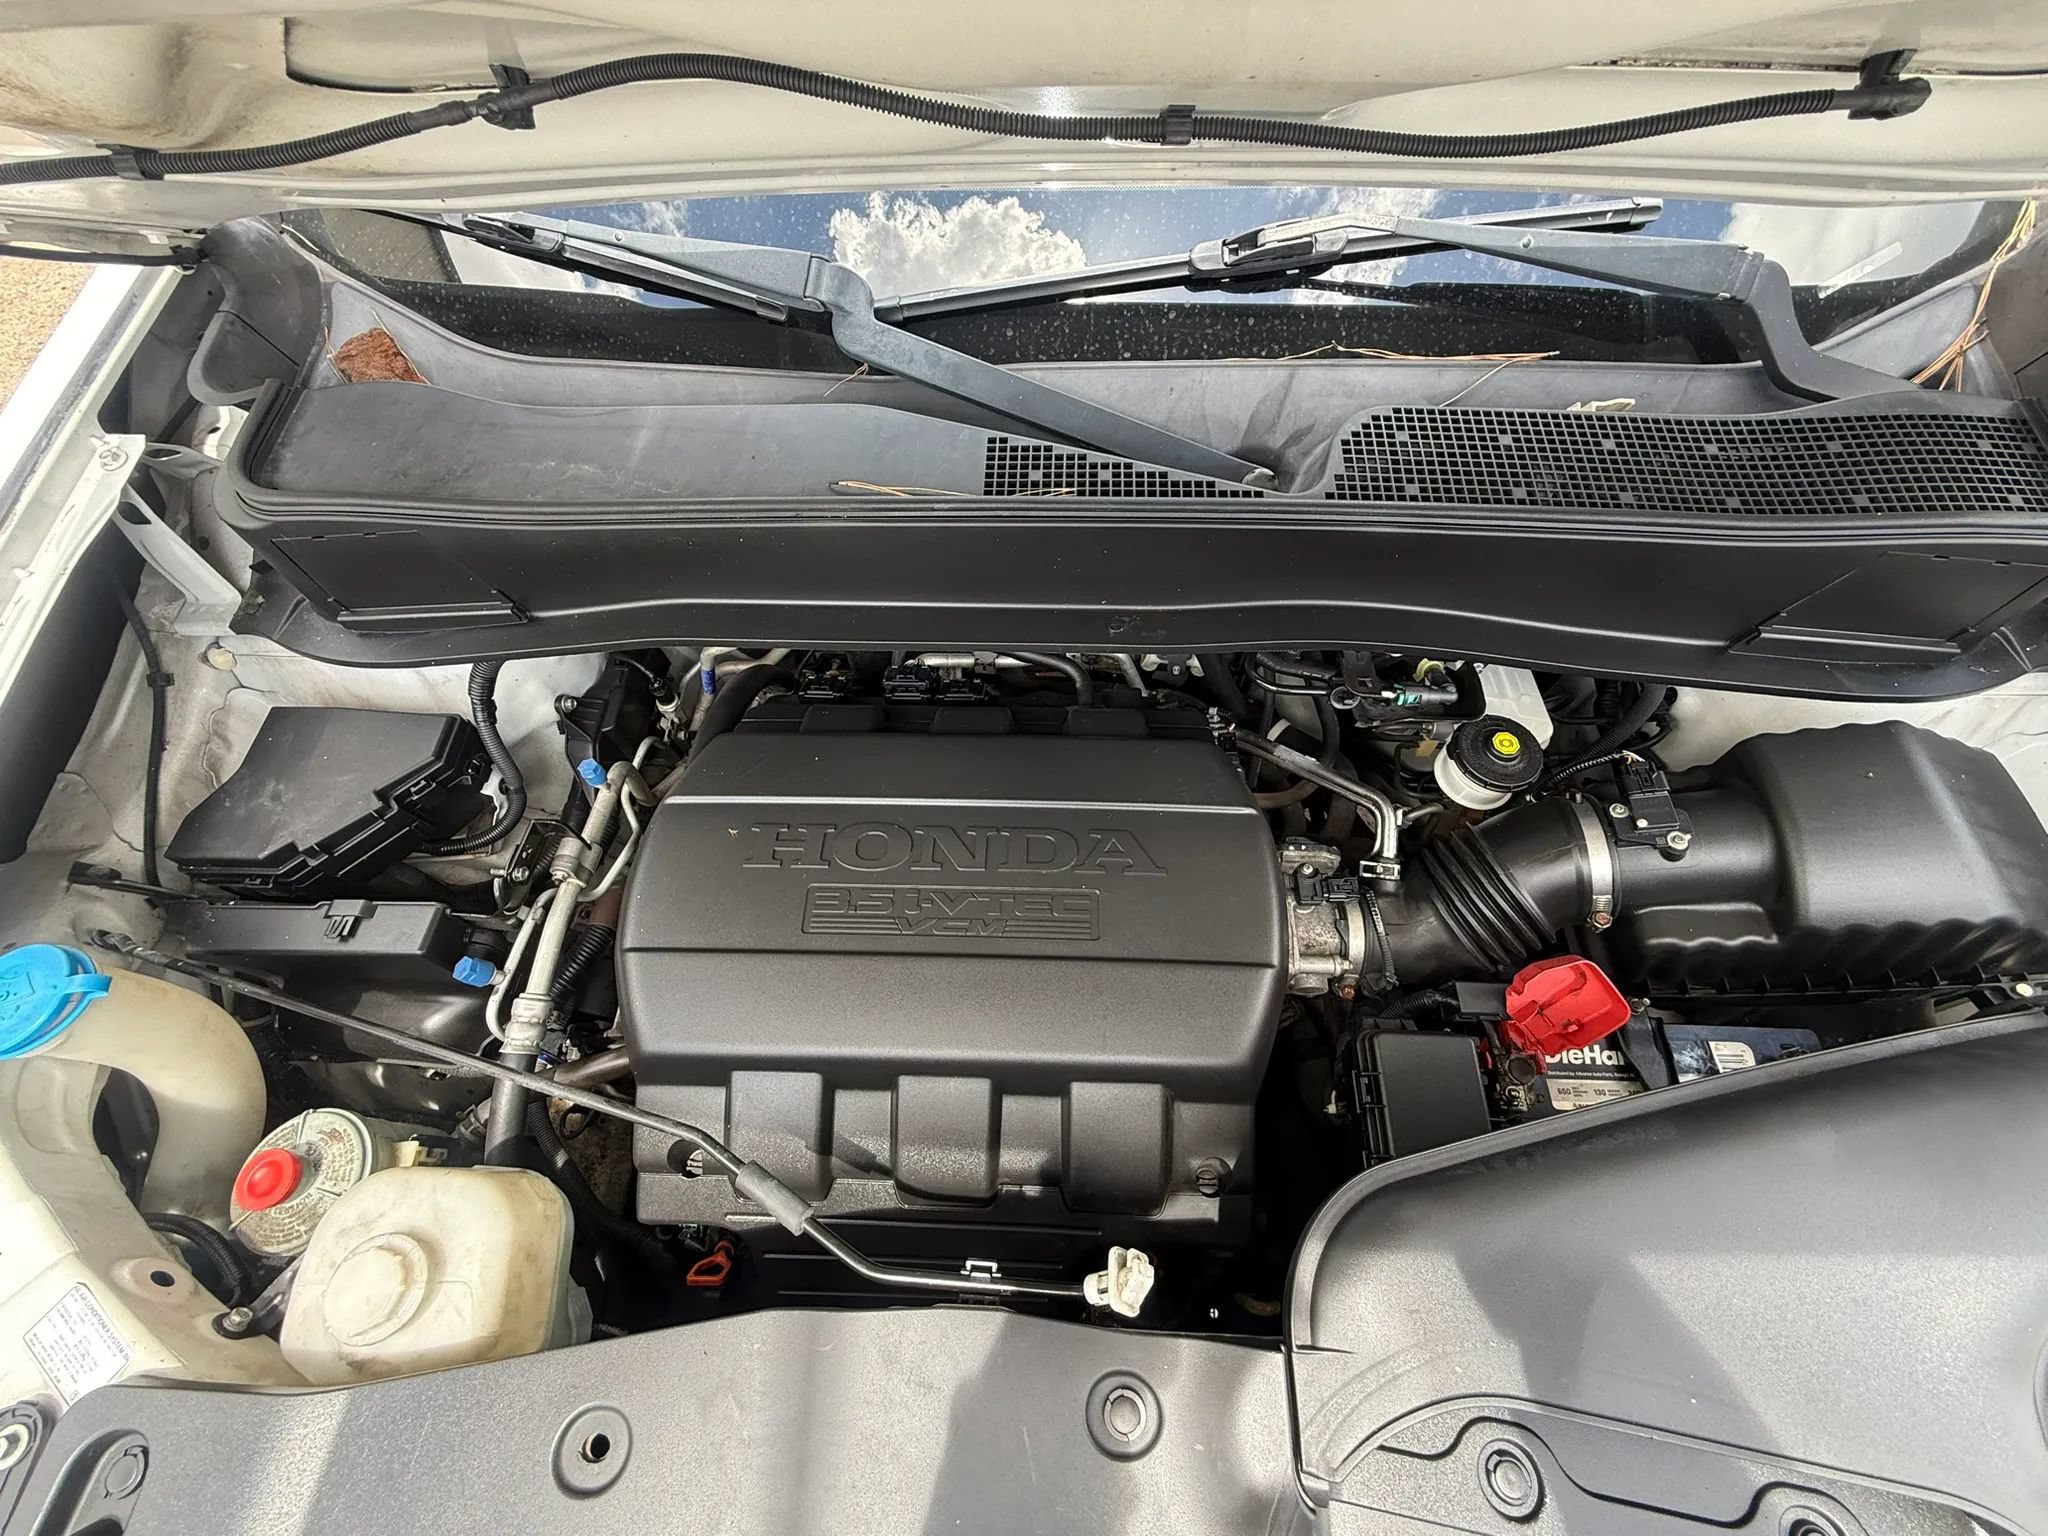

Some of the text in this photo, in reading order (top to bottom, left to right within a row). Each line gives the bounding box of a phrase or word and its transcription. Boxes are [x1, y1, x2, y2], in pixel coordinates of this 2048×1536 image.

[742, 822, 1168, 876] HONDA
[811, 887, 894, 914] 3.5
[894, 917, 1007, 936] VCM
